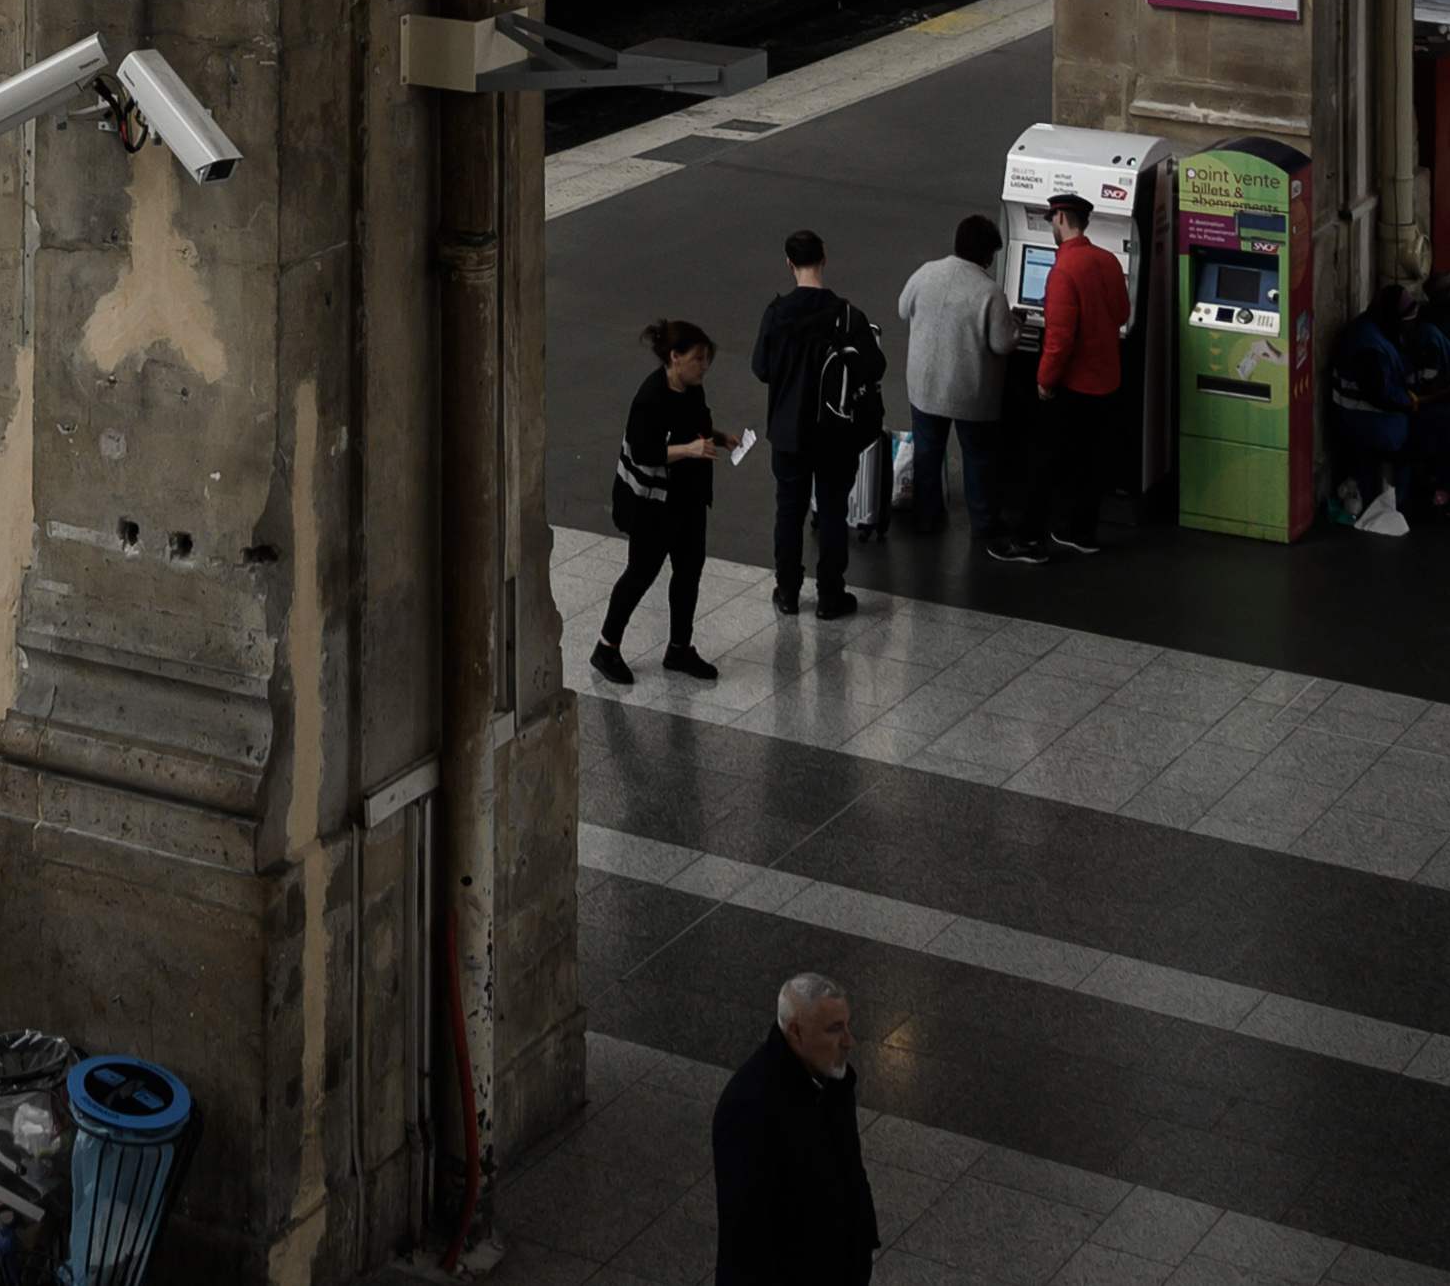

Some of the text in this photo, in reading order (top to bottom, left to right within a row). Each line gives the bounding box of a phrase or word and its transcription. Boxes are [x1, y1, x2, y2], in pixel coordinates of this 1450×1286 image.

[1011, 175, 1042, 183] GRANDES
[1186, 166, 1280, 189] point vente
[1103, 189, 1125, 198] SNCF
[1192, 181, 1244, 198] billets &
[1193, 194, 1276, 212] abonnements
[1253, 242, 1276, 251] SNCF
